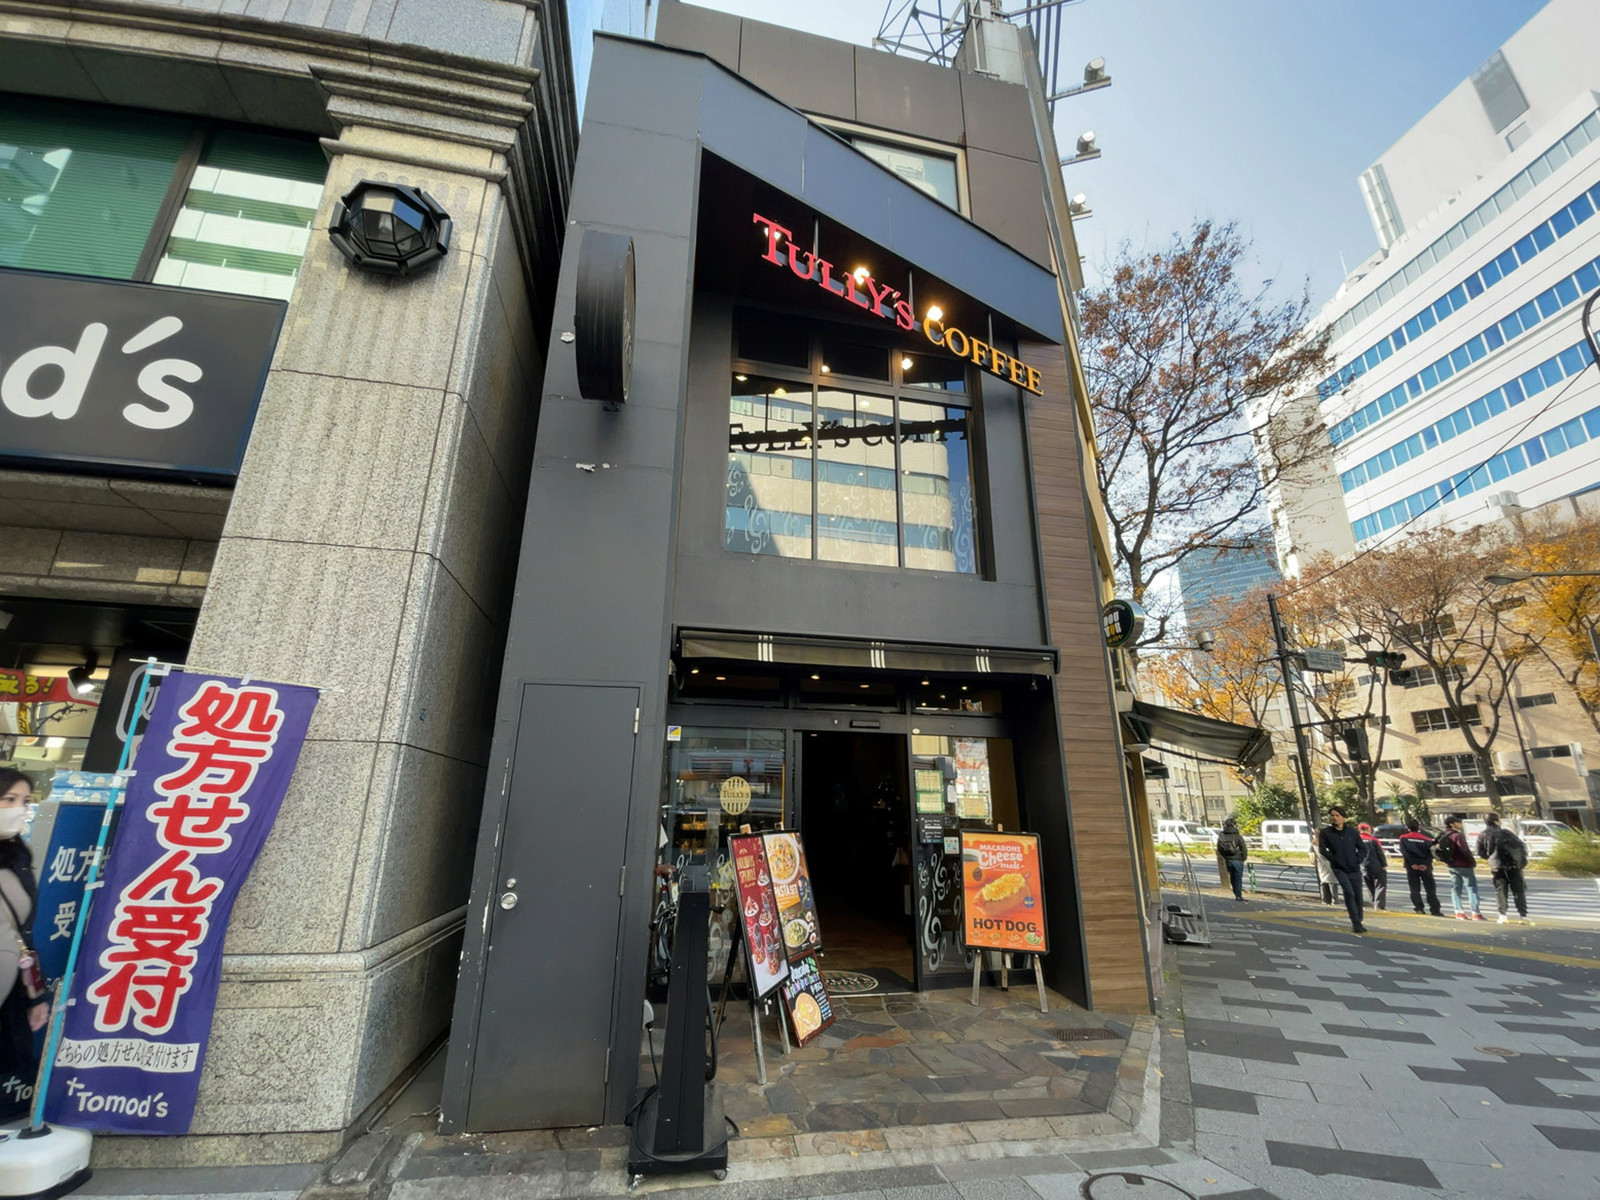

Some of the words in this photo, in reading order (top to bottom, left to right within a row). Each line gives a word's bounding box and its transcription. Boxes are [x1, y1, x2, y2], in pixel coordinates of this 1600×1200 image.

[752, 212, 914, 331] TULLY'S
[922, 316, 1045, 397] COFFEE
[86, 679, 285, 1036] 処方せん受付
[977, 850, 1024, 868] Cheese
[979, 844, 1022, 853] MACARONI
[973, 917, 1004, 931] HOT
[1005, 920, 1037, 934] DOG
[76, 1091, 169, 1118] Tomod's
